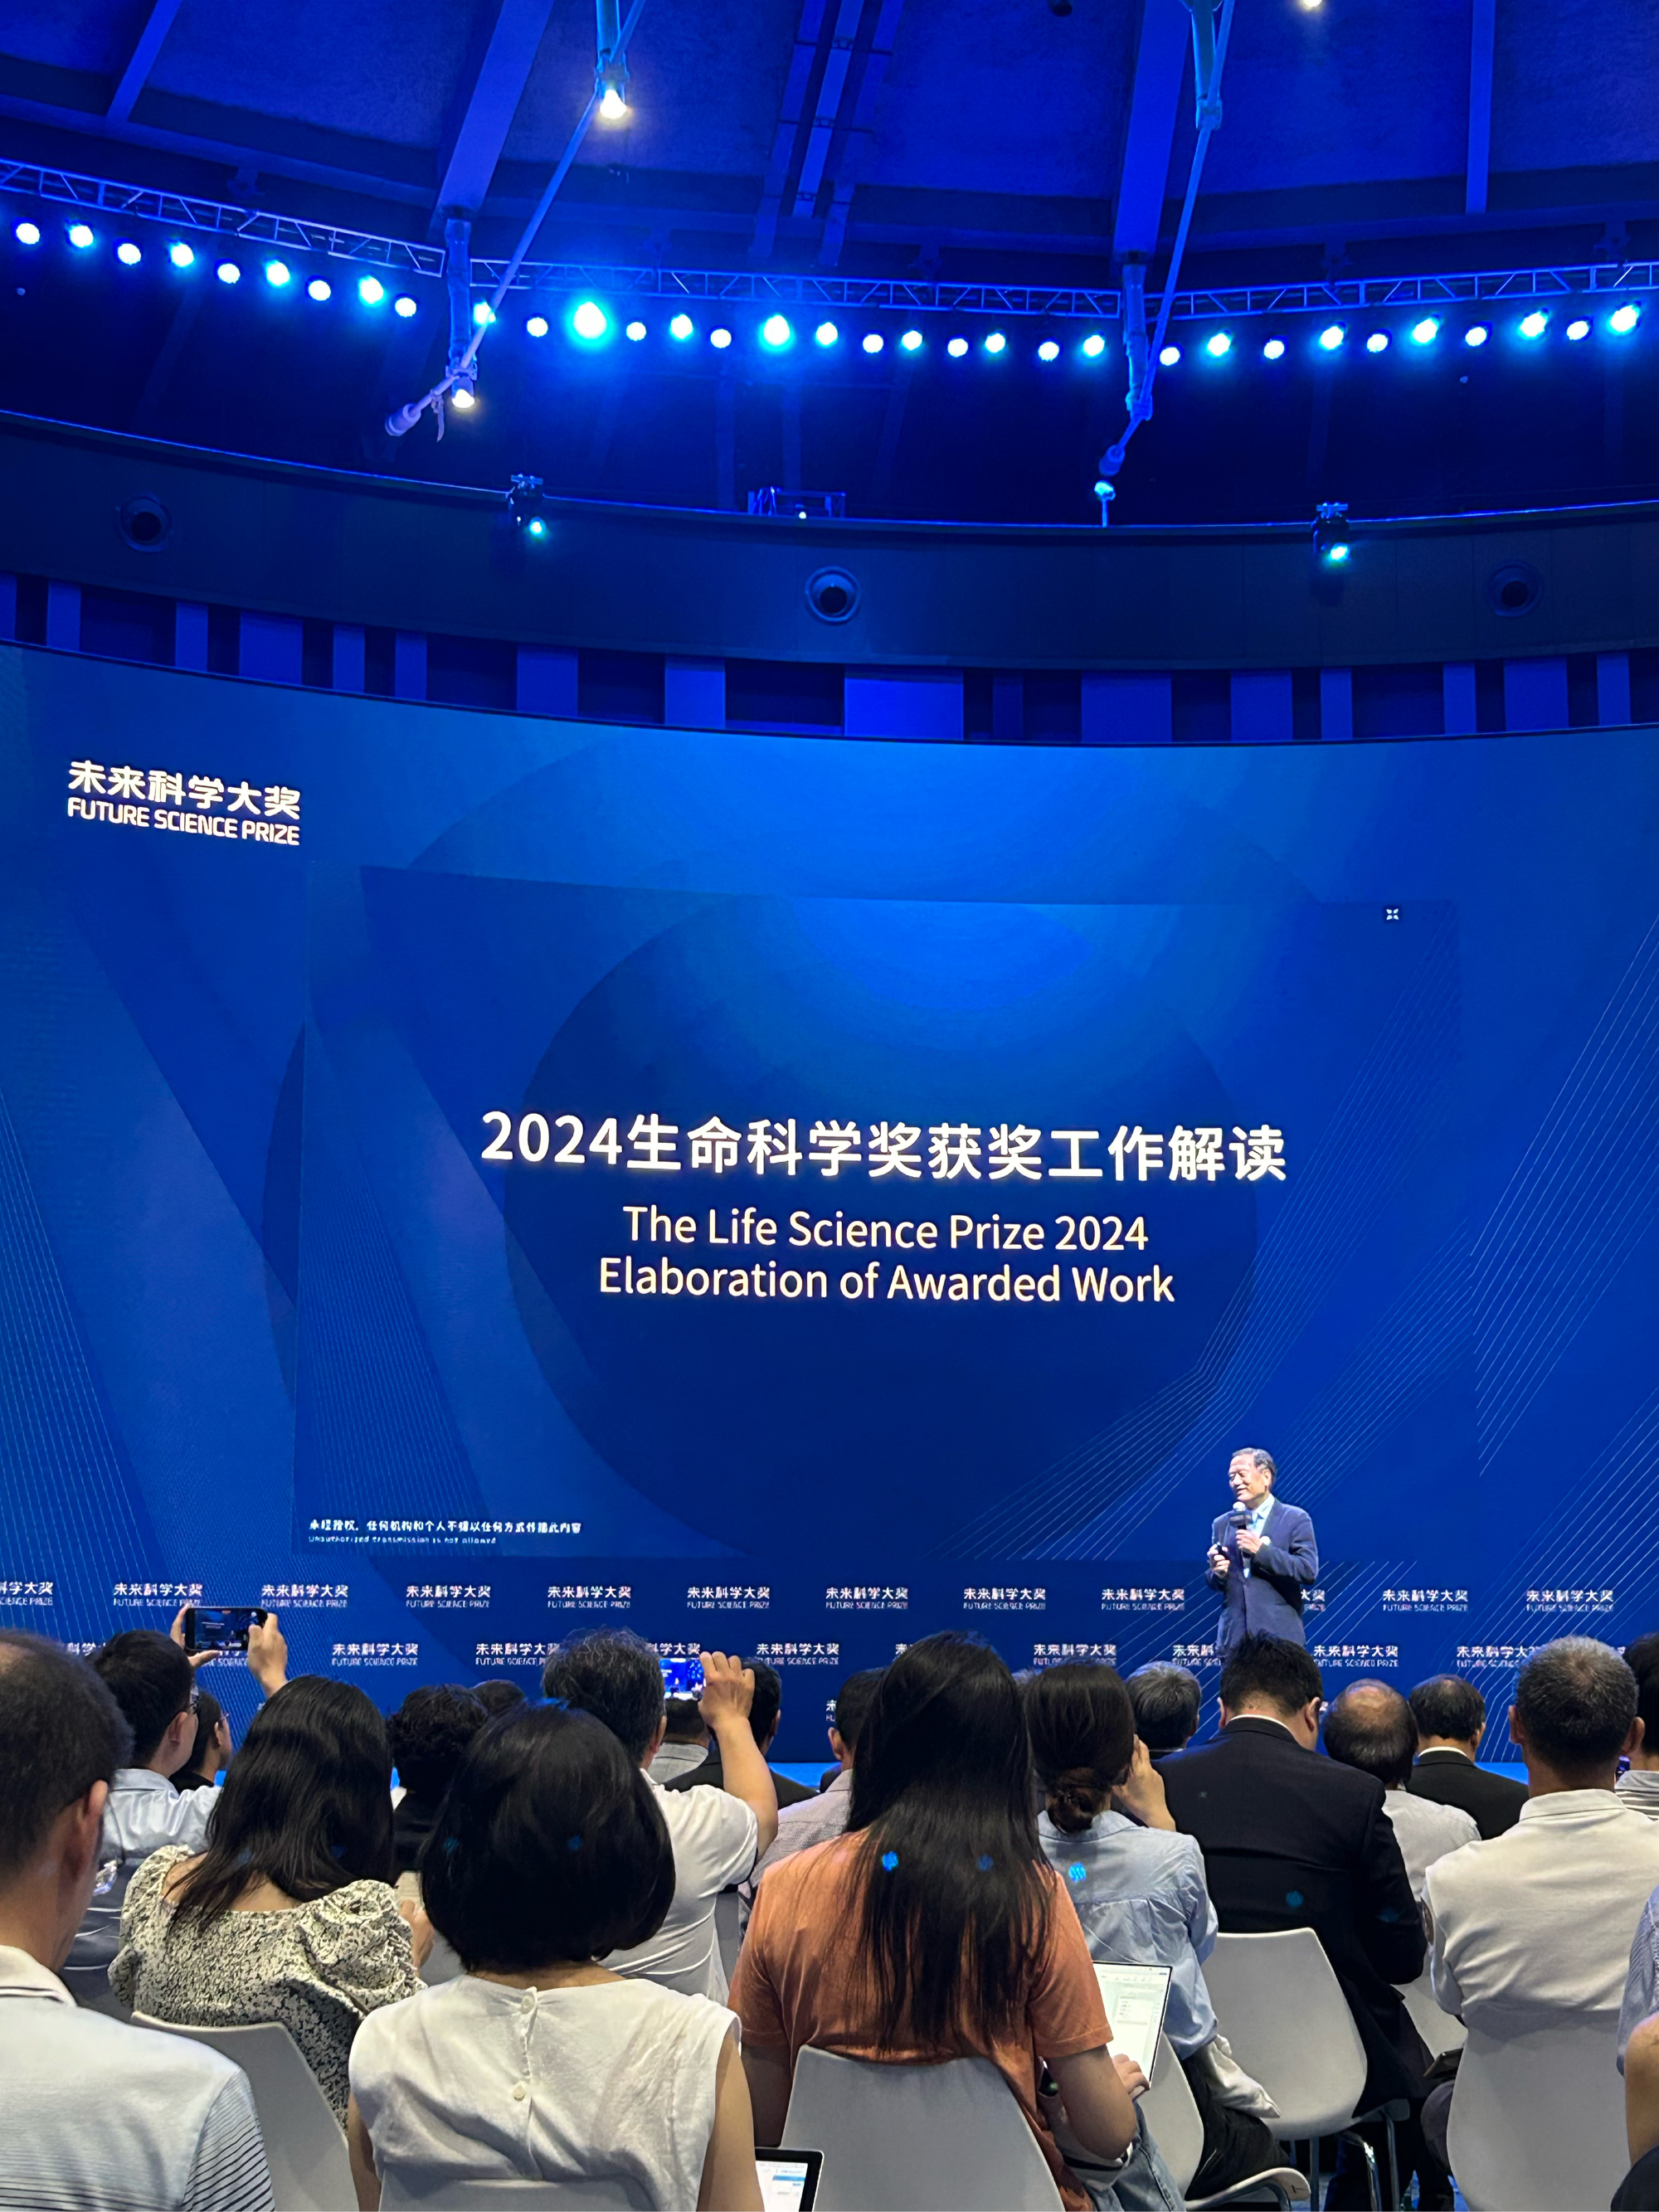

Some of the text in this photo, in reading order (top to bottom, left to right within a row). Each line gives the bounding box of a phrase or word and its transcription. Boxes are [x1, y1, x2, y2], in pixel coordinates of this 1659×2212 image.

[67, 760, 300, 819] 未来科学大奖
[67, 797, 300, 845] FUTURE SCIENCE PRIZE
[481, 1111, 1287, 1182] 2024生命科学奖获奖工作解读
[623, 1204, 1149, 1252] The Life Science Prize 2024
[600, 1257, 1175, 1303] Elaboration of Awarded Work
[114, 1582, 203, 1597] 未来科学大奖
[261, 1584, 348, 1597] 未来科学大奖
[406, 1585, 491, 1598] 未来科学大奖
[547, 1586, 631, 1598] 未来科学大奖
[688, 1587, 770, 1599] 未来科学大奖
[826, 1587, 908, 1600] 未来科学大奖
[964, 1588, 1046, 1600] 未来科学大奖
[1102, 1589, 1185, 1601] 未来科学大奖
[1384, 1590, 1467, 1602] 未来科学大奖
[1526, 1590, 1613, 1602] 未来科学大奖
[332, 1643, 419, 1655] 未来科学大奖
[757, 1643, 839, 1655] 未来科学大奖
[1313, 1645, 1399, 1657] 未来科学大奖
